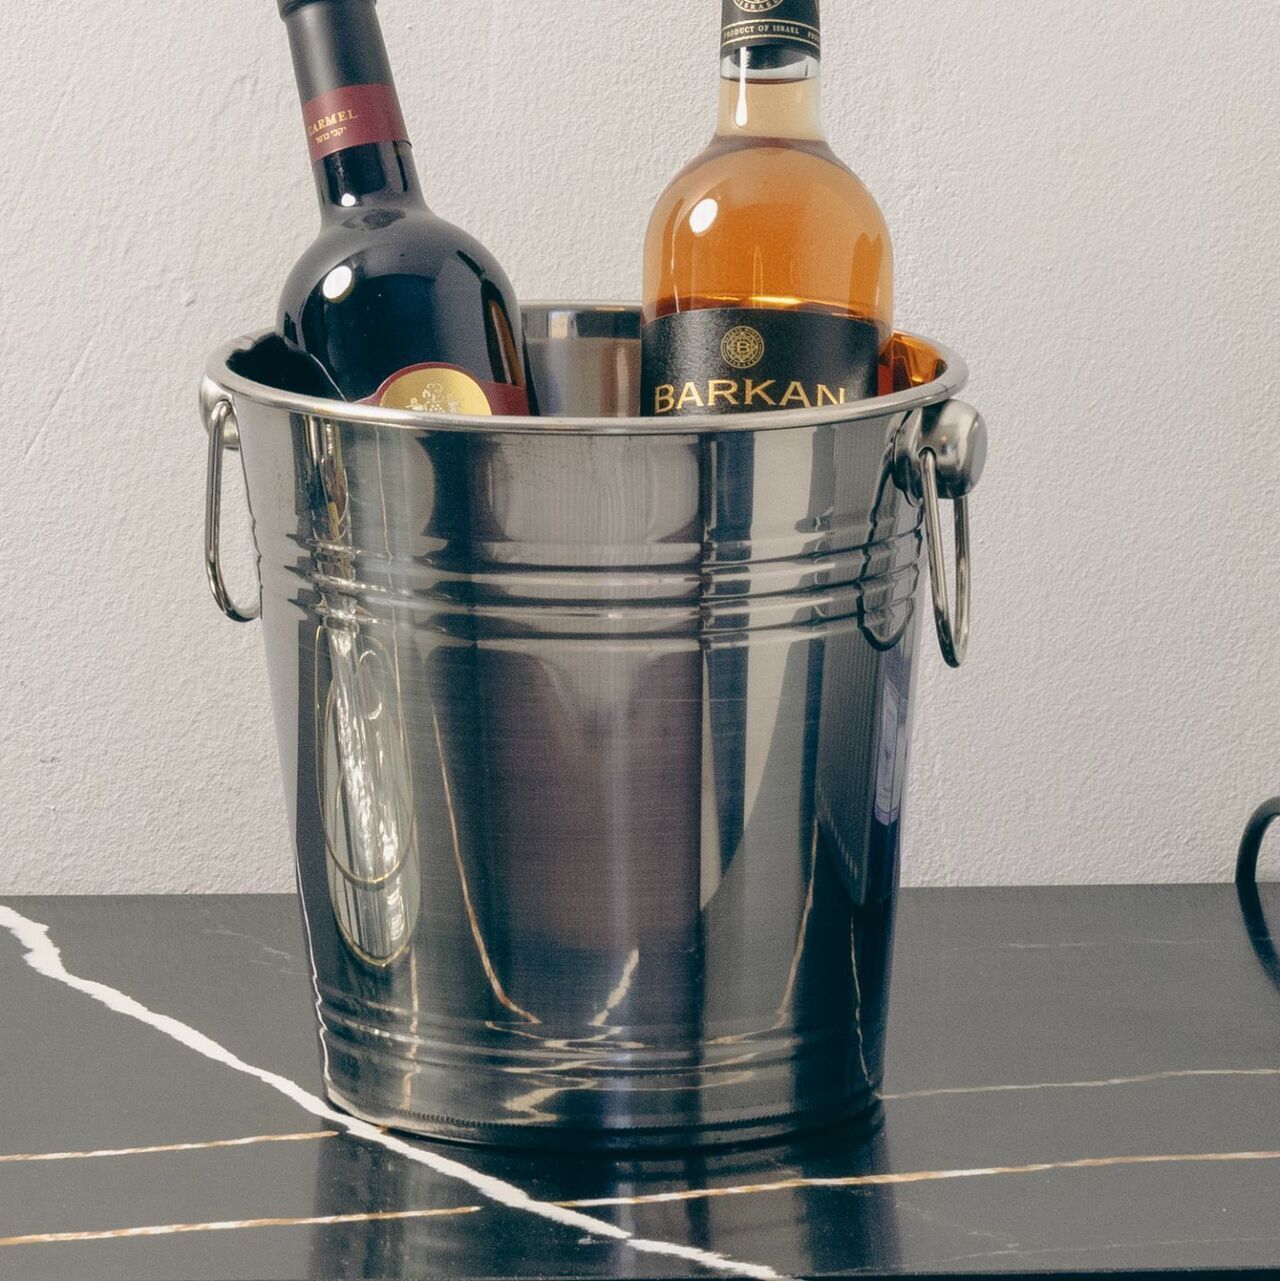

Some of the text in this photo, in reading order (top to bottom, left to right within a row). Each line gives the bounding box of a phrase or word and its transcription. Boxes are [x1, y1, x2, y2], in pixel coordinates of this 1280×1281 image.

[757, 24, 770, 34] OF
[772, 24, 800, 35] ISRAEL
[654, 378, 846, 415] BARKAN
